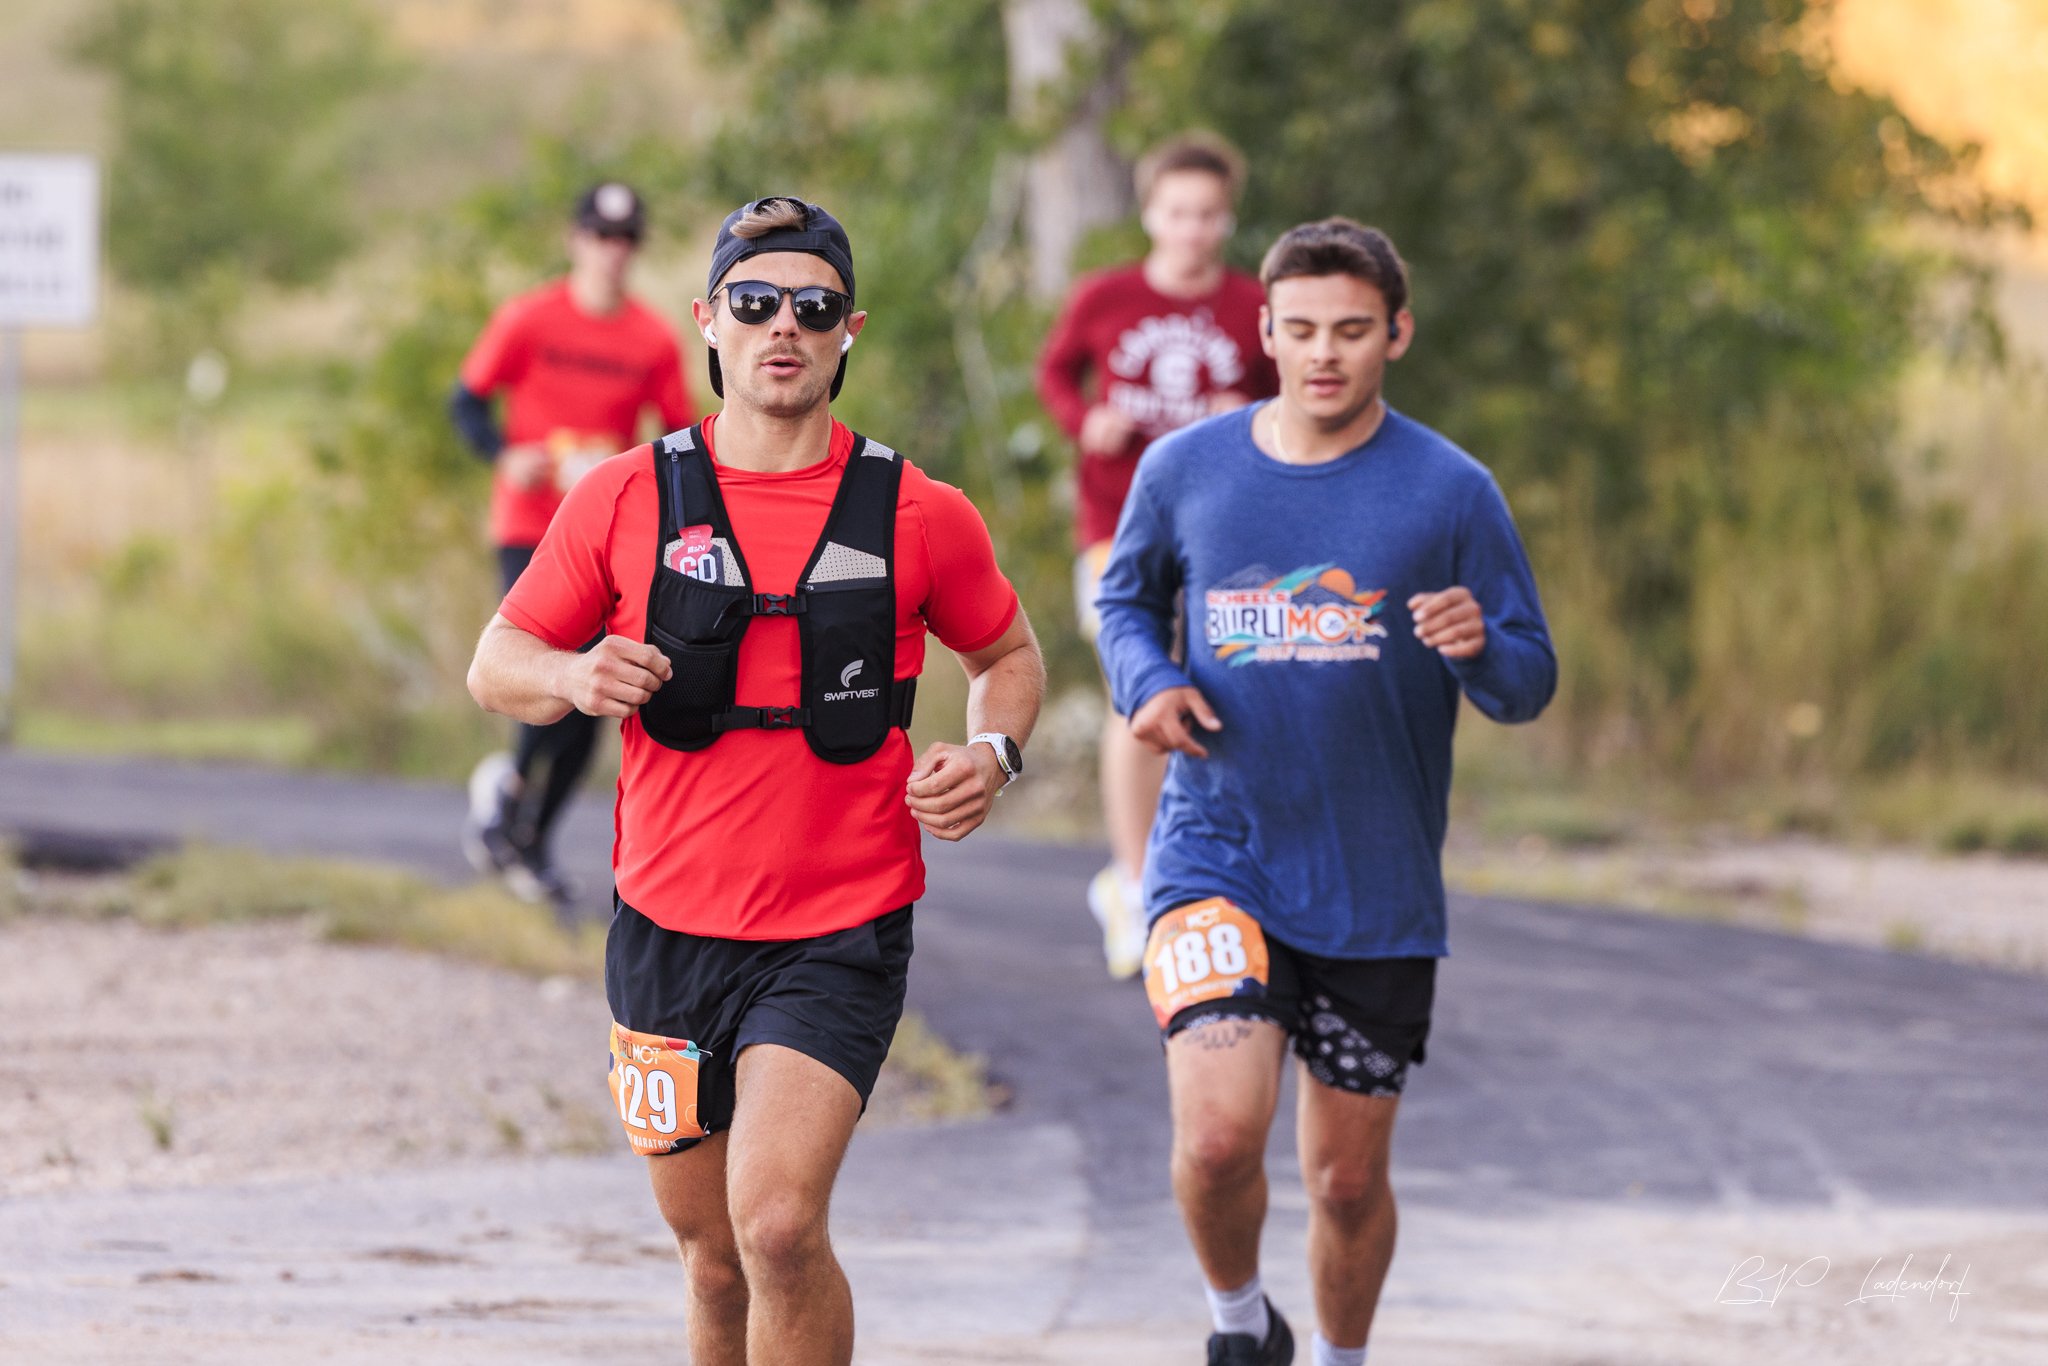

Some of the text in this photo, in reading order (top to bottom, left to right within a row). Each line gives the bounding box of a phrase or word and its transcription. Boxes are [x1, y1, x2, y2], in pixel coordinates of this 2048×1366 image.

[824, 688, 879, 701] SWIFTVEST
[1154, 923, 1247, 994] 188
[617, 1060, 678, 1134] 129
[634, 1136, 678, 1150] MARATHON
